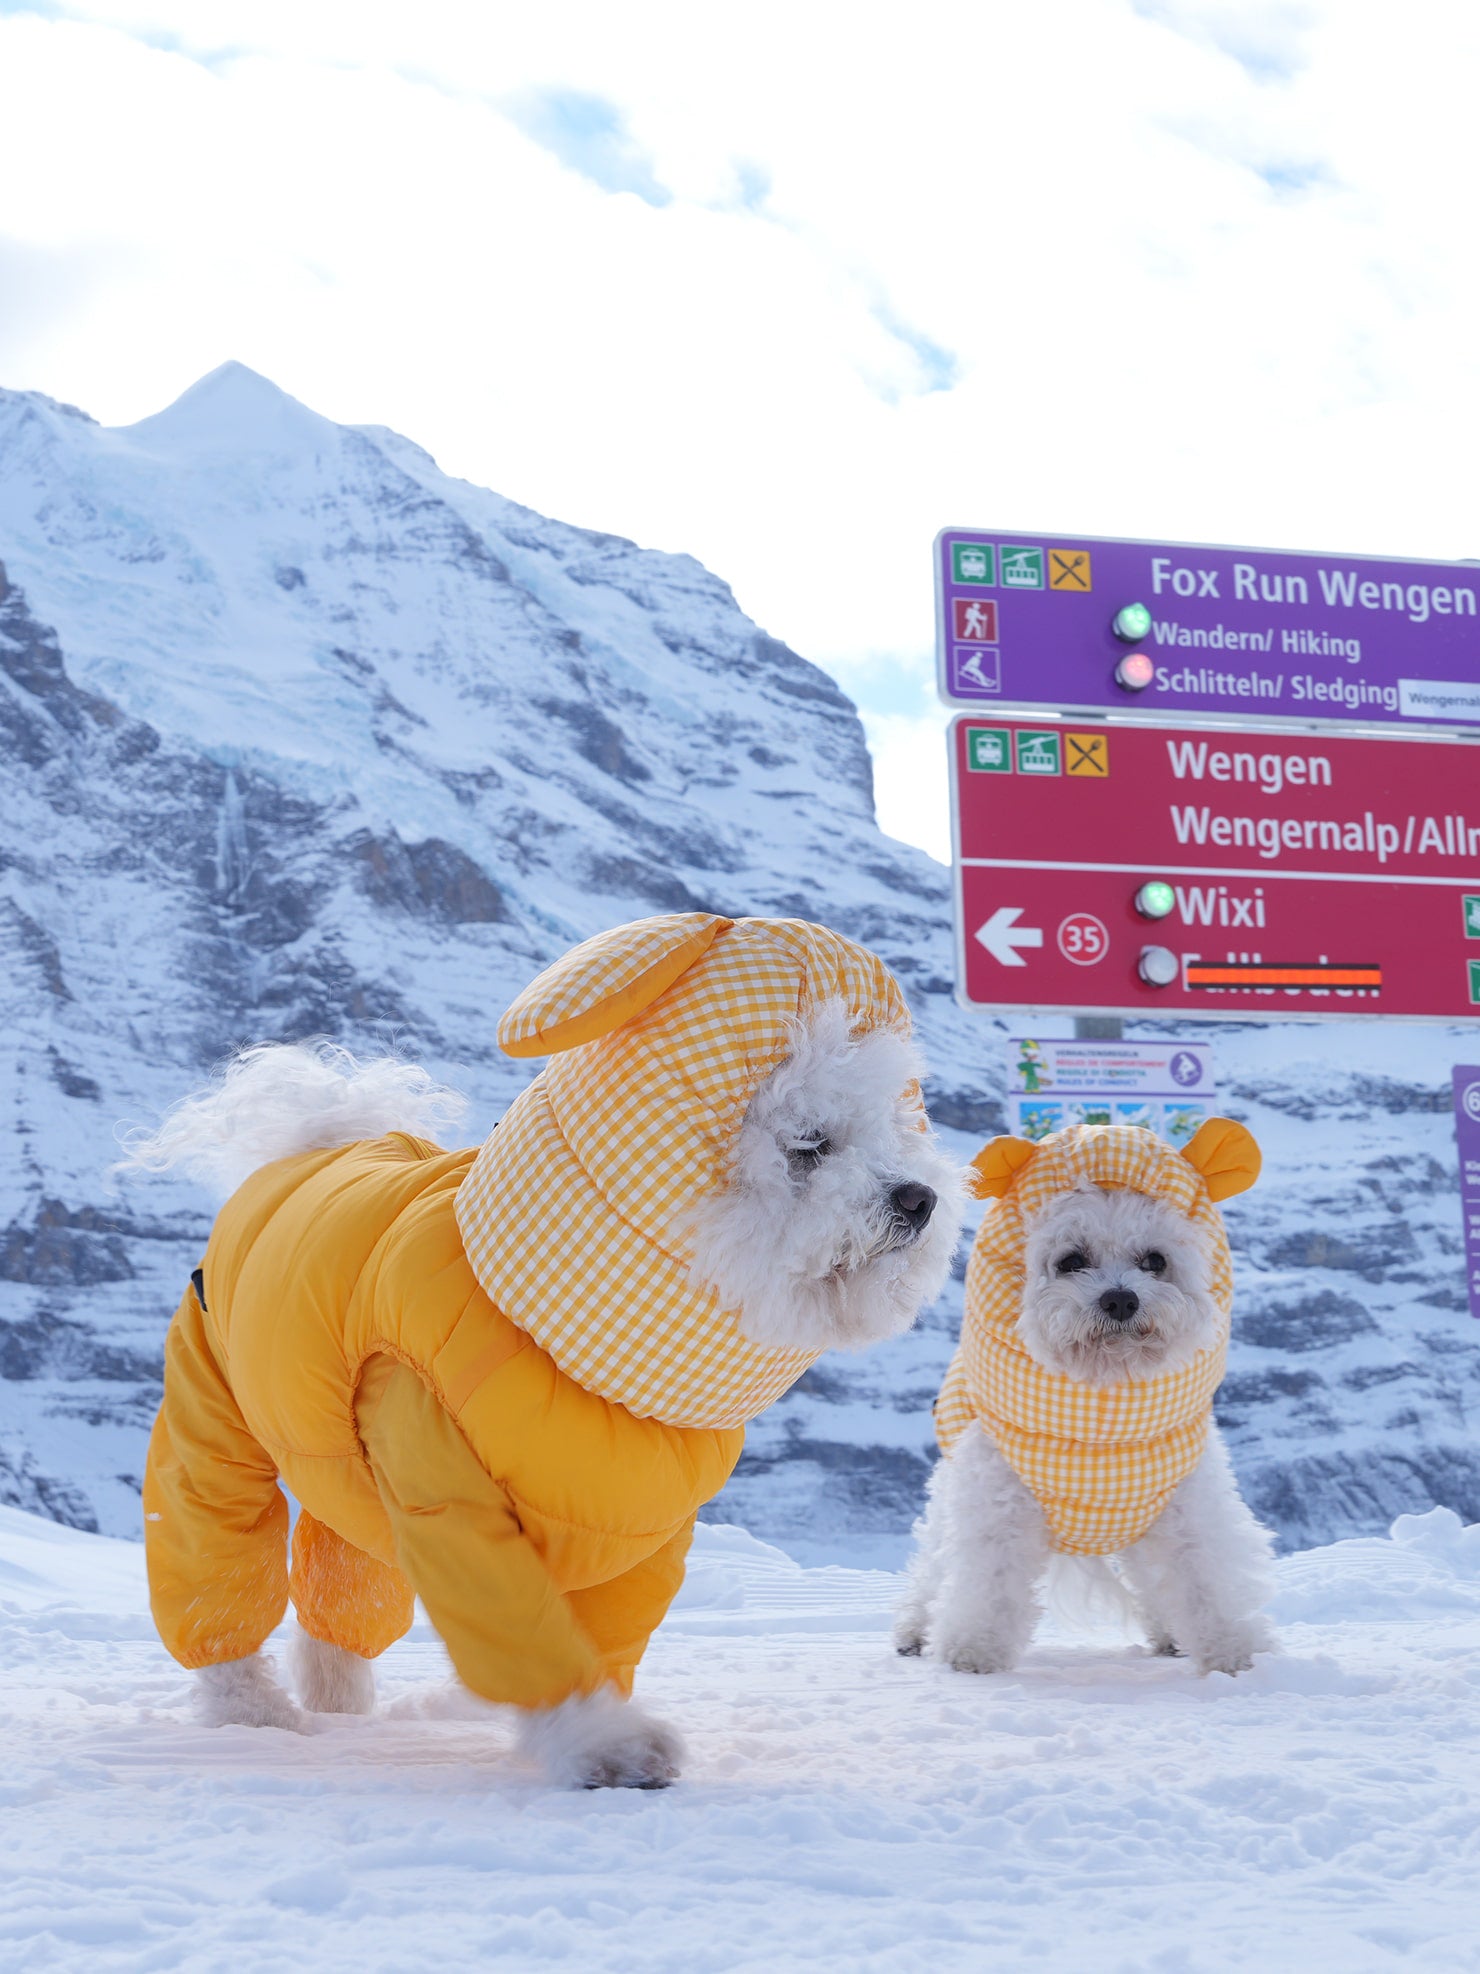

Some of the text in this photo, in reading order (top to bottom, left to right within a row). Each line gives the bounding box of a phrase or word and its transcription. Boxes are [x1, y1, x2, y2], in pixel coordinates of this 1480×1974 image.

[1151, 557, 1478, 623] Fox Run Wengen
[1152, 620, 1361, 664] Wandern/ Hiking
[1155, 666, 1398, 711] Schlitteln/ Sledging
[1166, 740, 1333, 794] Wengen
[1175, 886, 1266, 928] Wixi
[1065, 924, 1101, 954] 35
